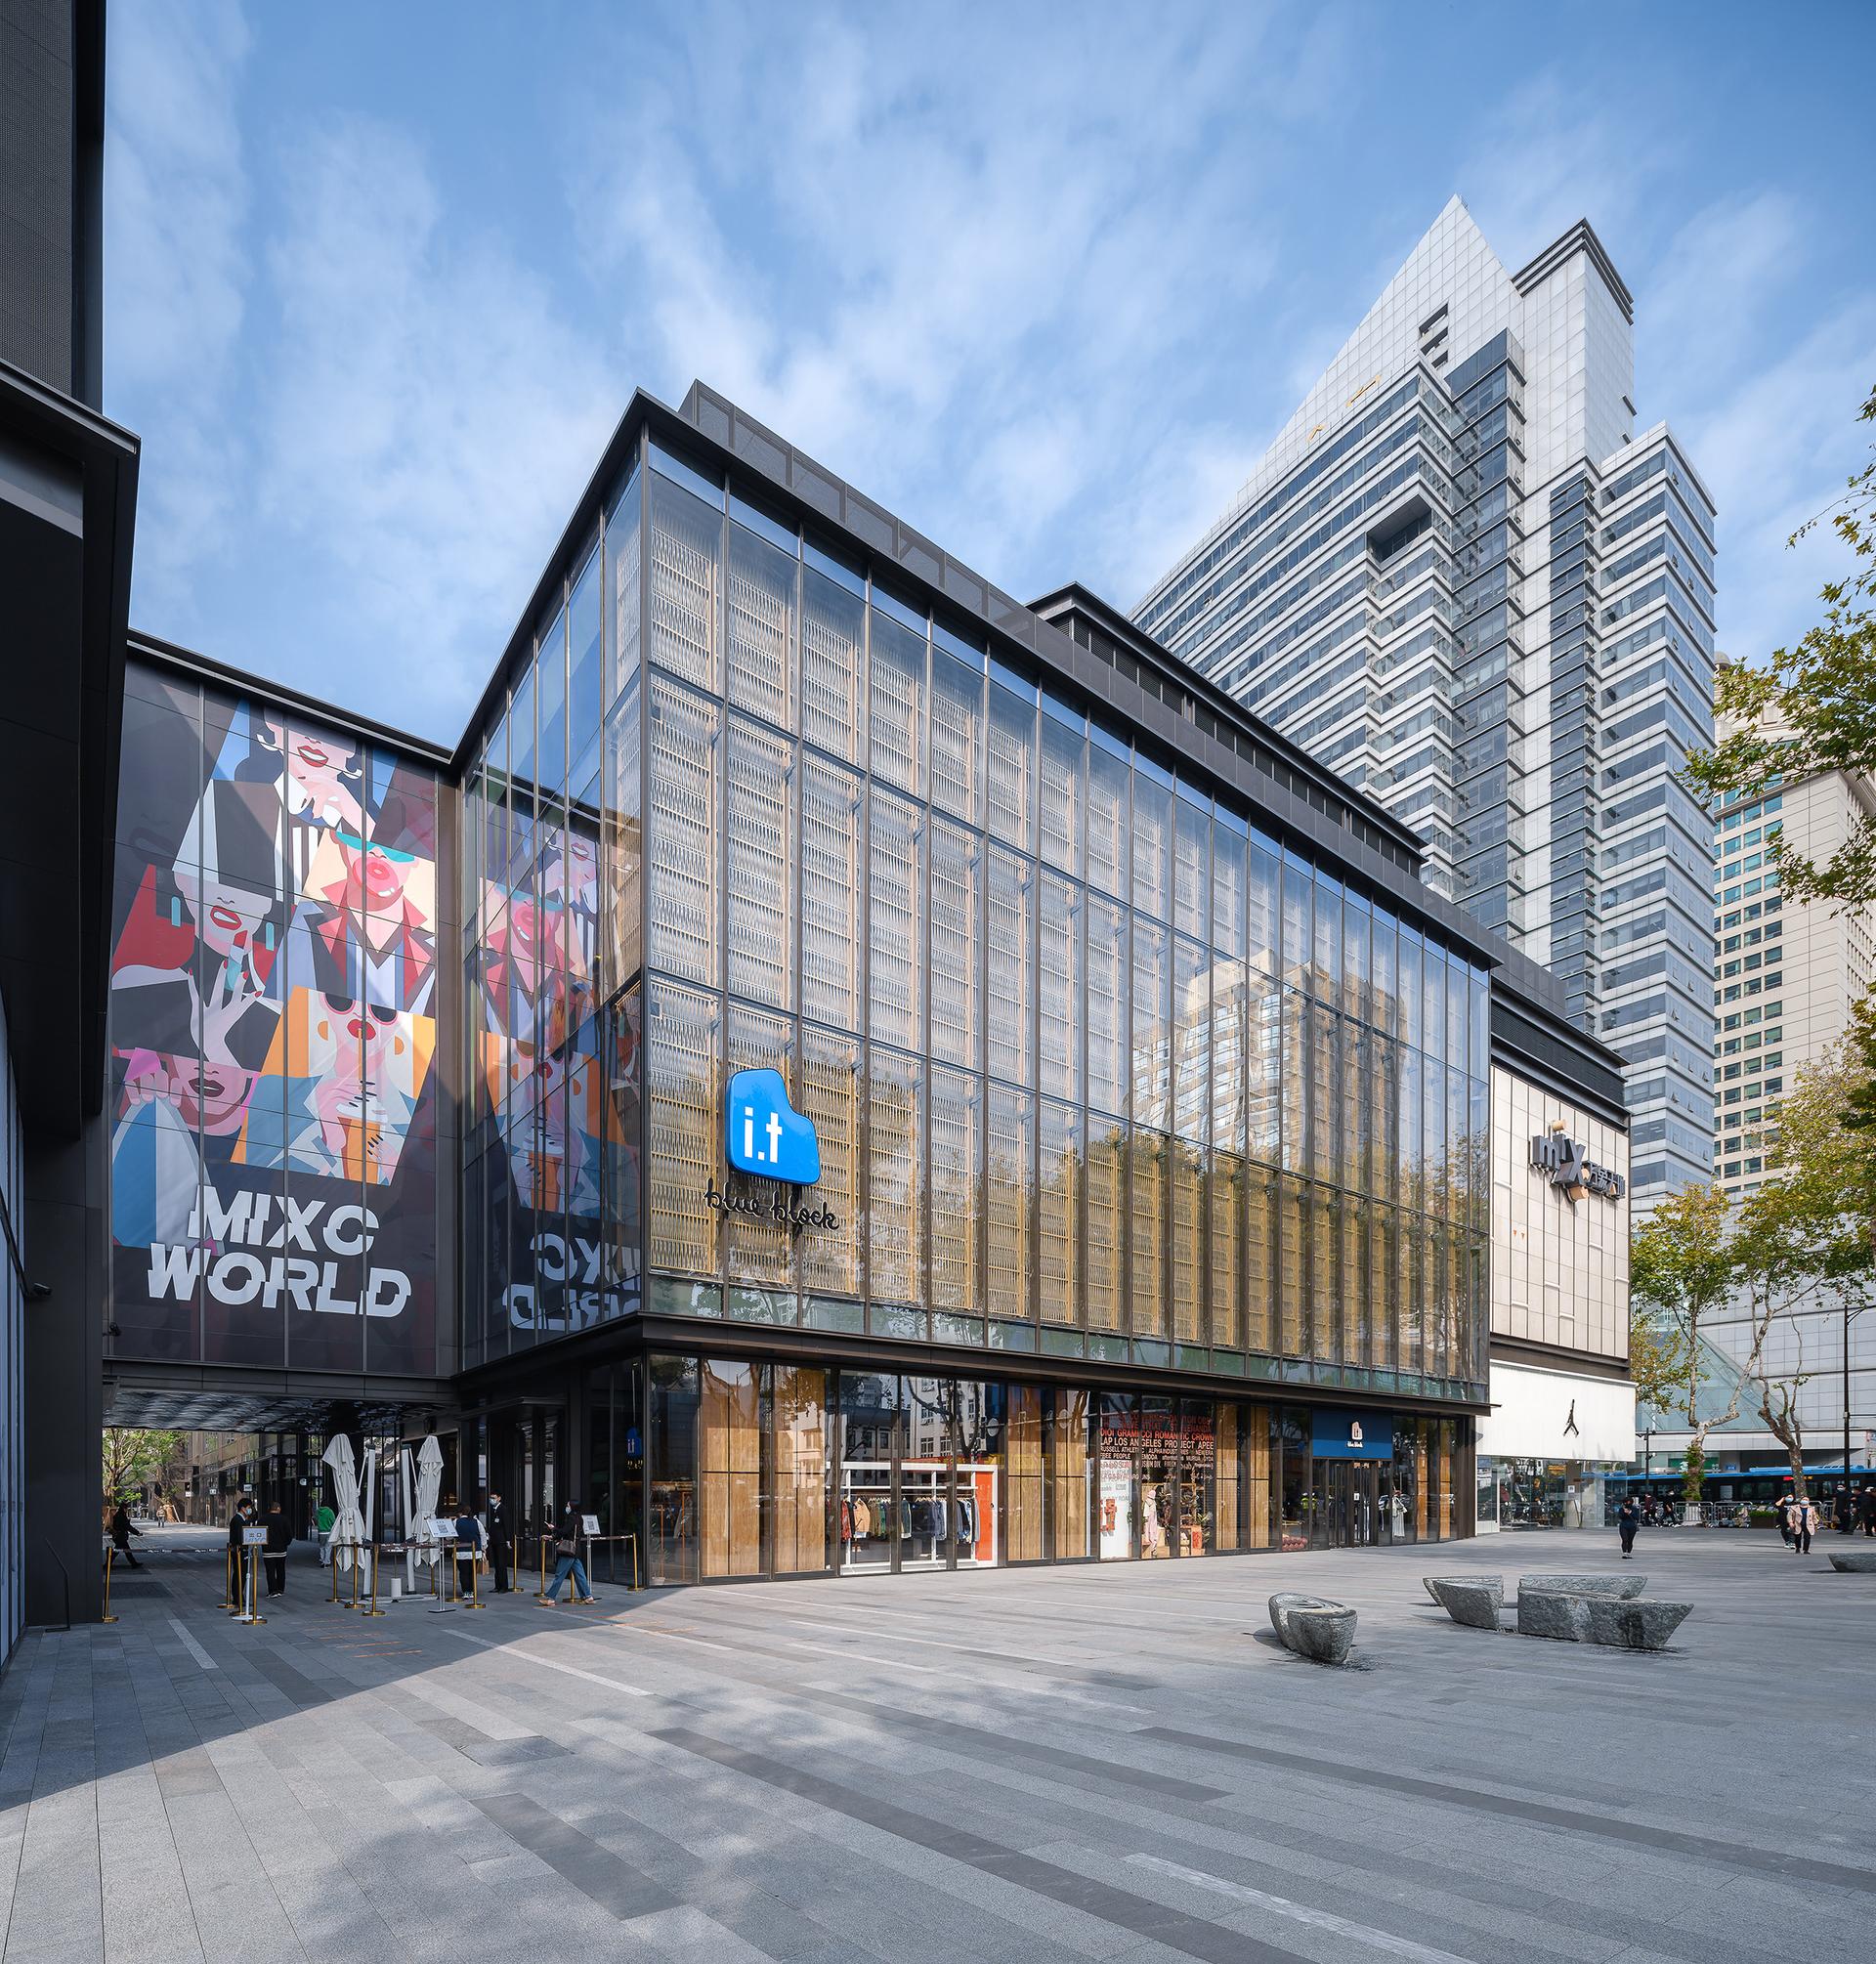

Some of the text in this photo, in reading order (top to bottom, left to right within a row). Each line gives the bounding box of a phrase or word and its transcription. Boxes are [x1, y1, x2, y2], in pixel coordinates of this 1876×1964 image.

[744, 1105, 783, 1164] i.t
[188, 1185, 380, 1257] MIXC
[703, 1176, 840, 1231] blue block
[148, 1242, 412, 1318] WORLD
[1114, 1437, 1129, 1446] LOS
[1130, 1437, 1162, 1447] ANGELES
[1164, 1439, 1195, 1449] PROJECT
